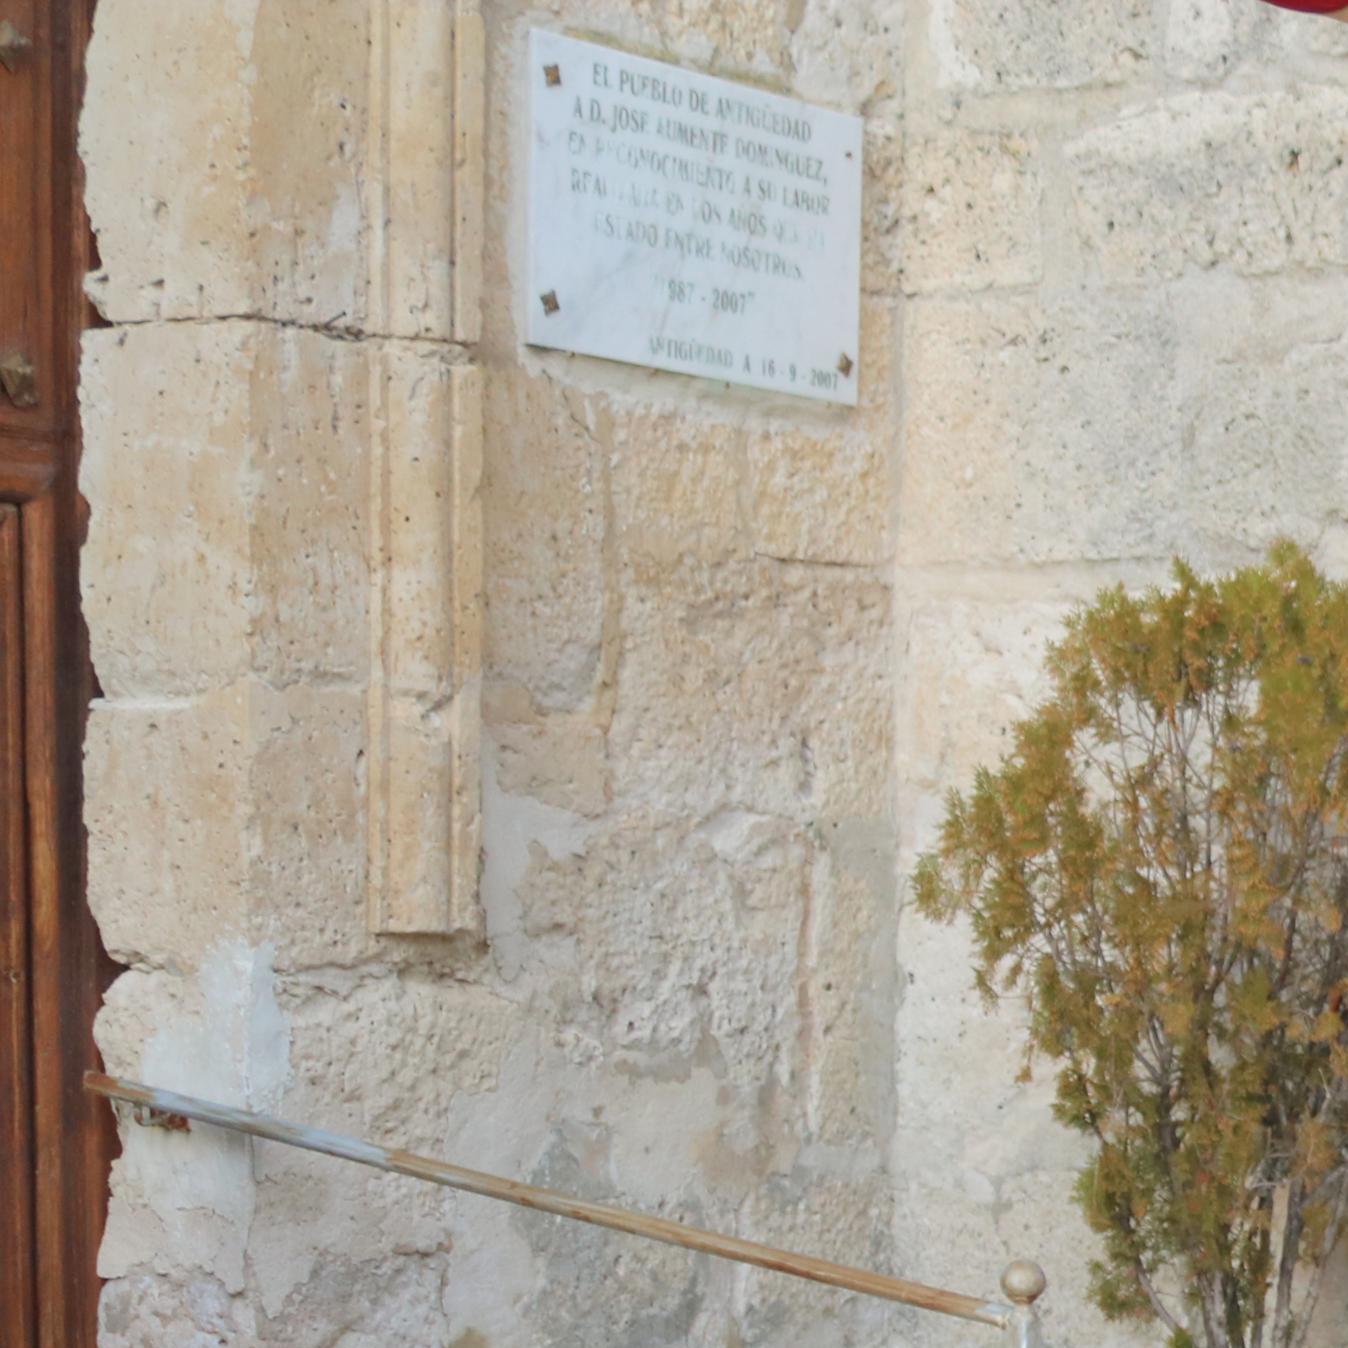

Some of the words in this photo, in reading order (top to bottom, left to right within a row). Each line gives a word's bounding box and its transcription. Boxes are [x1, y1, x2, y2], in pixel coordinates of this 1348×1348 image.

[573, 95, 583, 118] A
[589, 99, 605, 124] D.
[592, 63, 611, 88] EL
[619, 72, 682, 107] PUEBLO
[688, 89, 709, 114] DE
[567, 131, 586, 156] EN
[743, 175, 752, 196] A
[783, 187, 830, 215] LABOR
[742, 355, 751, 372] A
[760, 358, 776, 377] 16
[788, 364, 797, 381] 9
[810, 372, 838, 389] 2007
